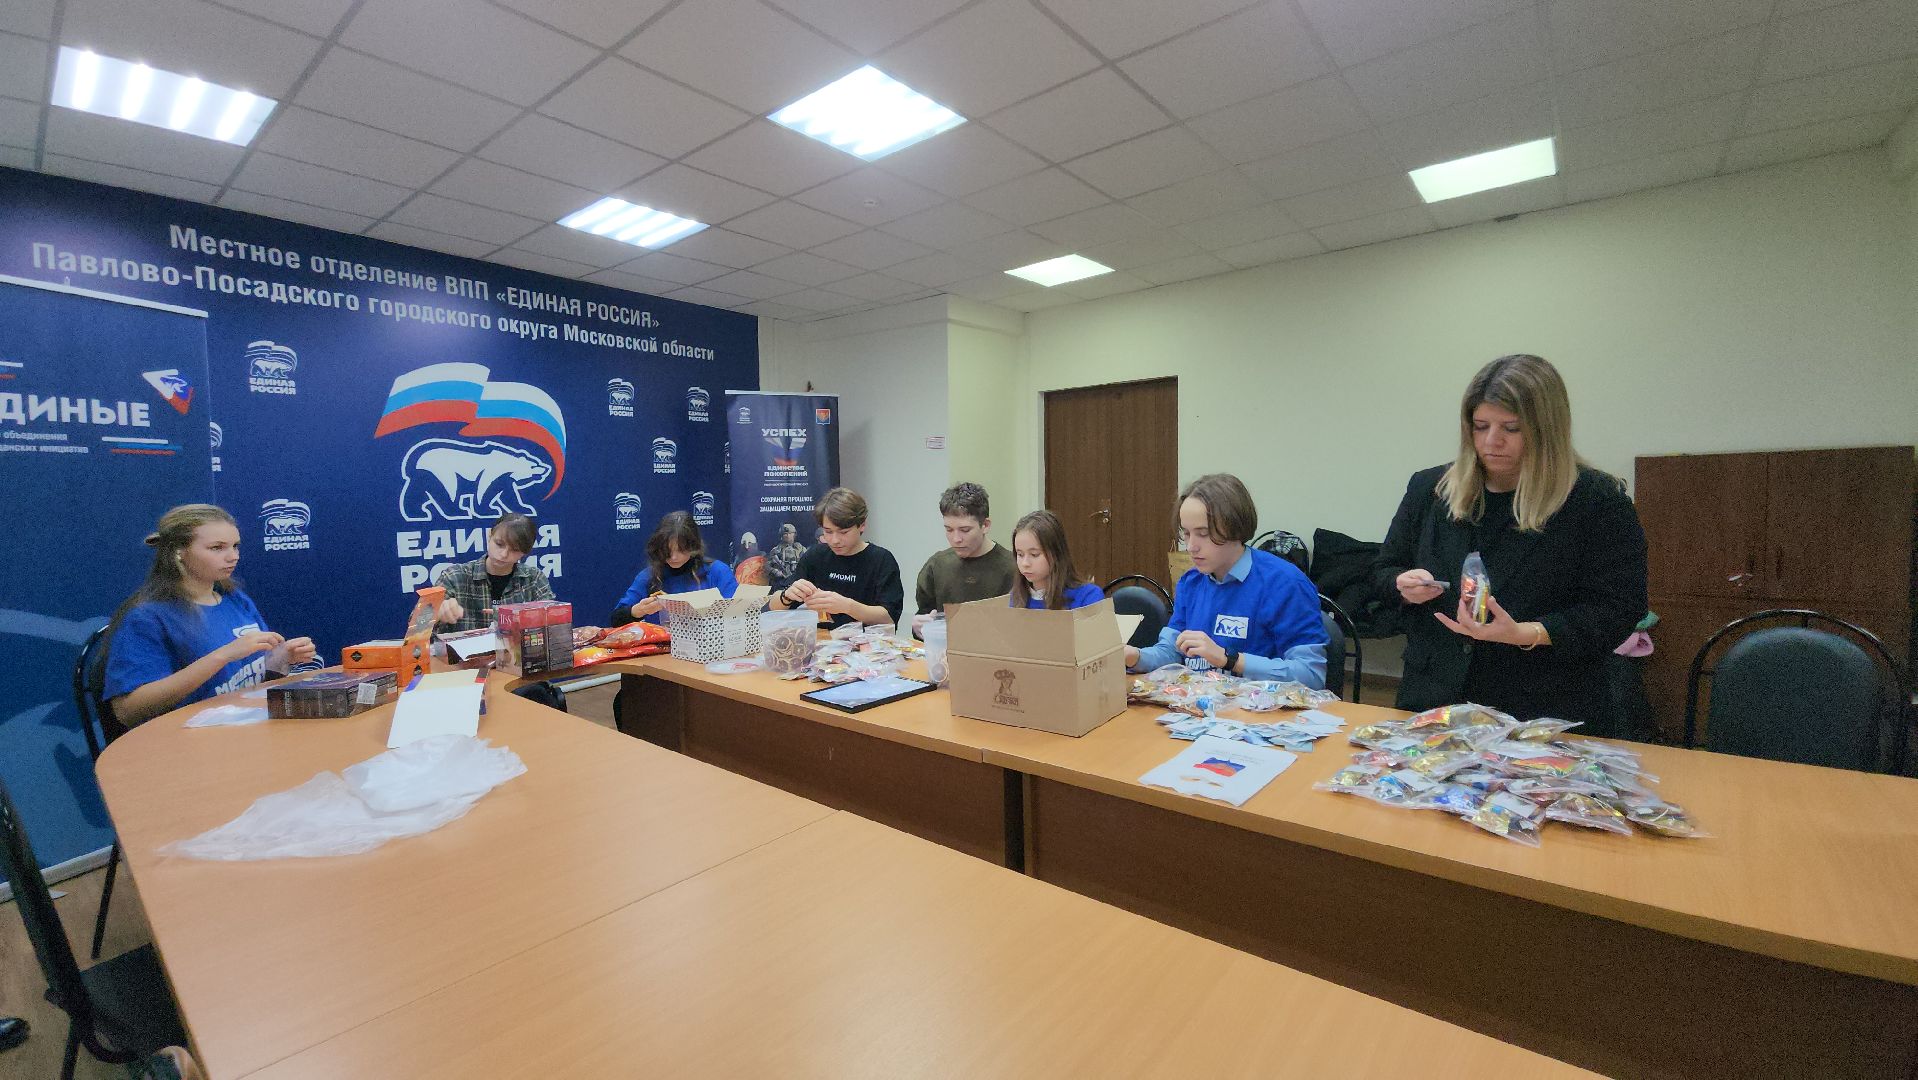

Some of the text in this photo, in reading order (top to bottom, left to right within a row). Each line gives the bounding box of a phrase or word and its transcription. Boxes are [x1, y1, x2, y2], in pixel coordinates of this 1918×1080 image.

[169, 224, 660, 329] Местное отделение ВПП «ЕДИНАЯ РОССИЯ»
[33, 242, 715, 361] Павлово-Посадского городского округа Московской области
[249, 377, 296, 388] ЕДИНАЯ
[250, 385, 297, 395] РОССИЯ
[761, 428, 807, 437] УСПЕХ
[396, 524, 561, 560] ЕДИЯ
